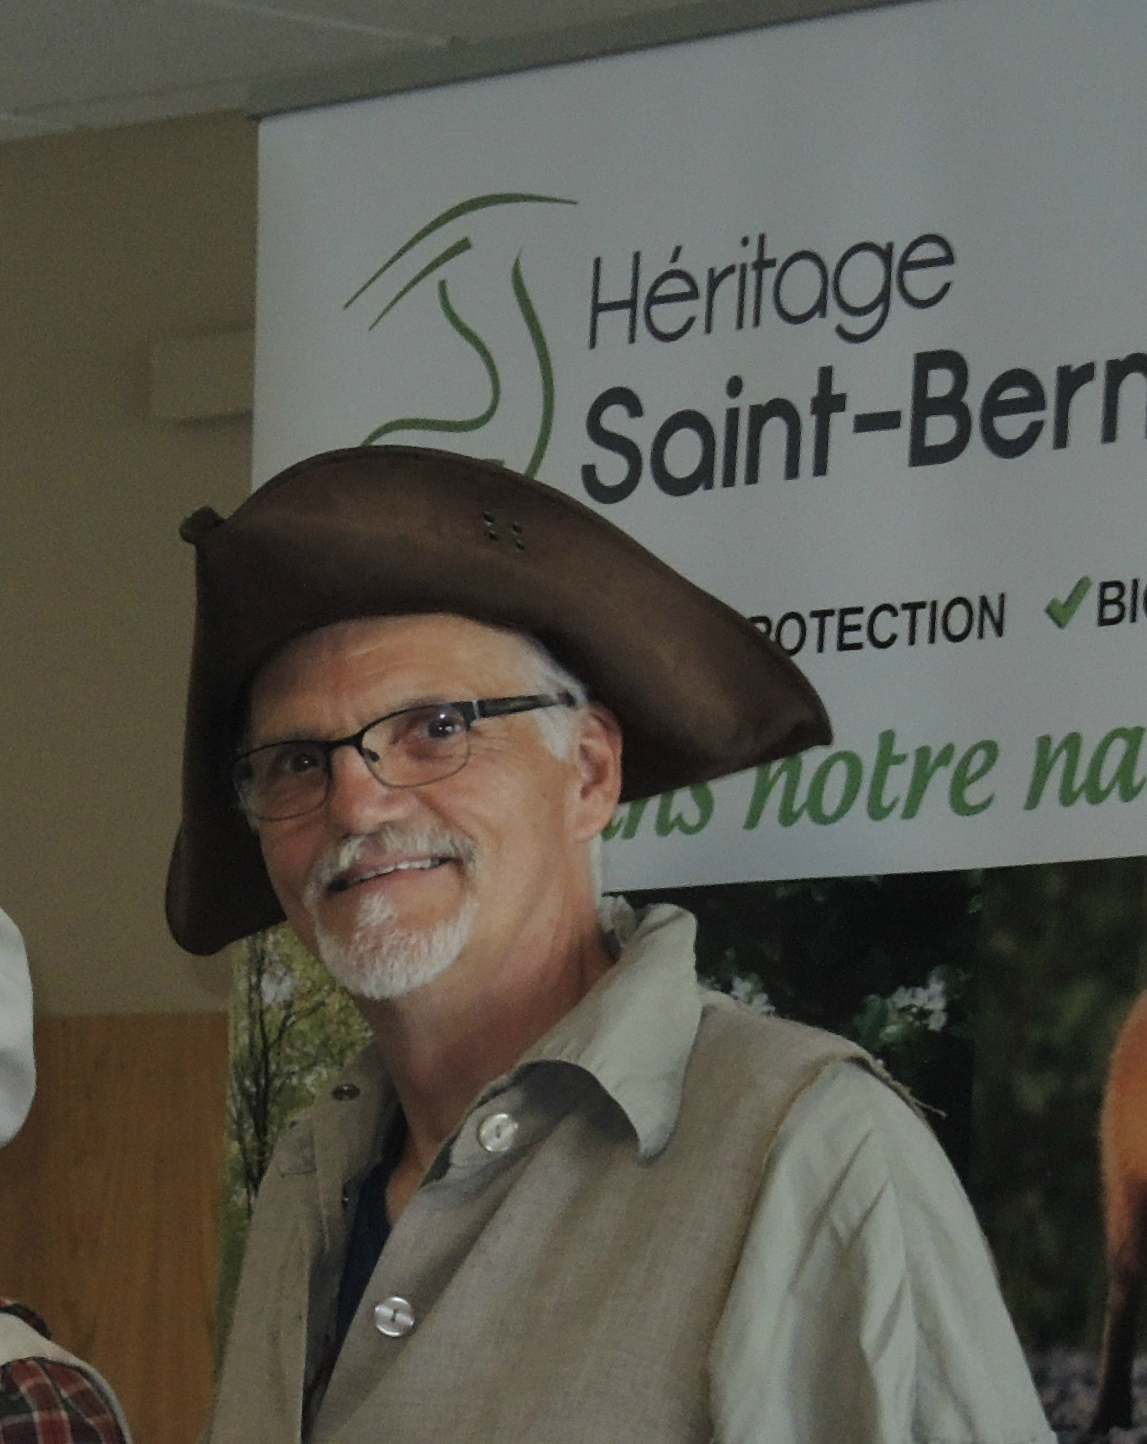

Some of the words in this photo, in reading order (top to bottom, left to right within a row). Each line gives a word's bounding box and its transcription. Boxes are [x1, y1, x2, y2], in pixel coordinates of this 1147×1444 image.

[587, 231, 956, 350] Héritage
[1097, 577, 1147, 627] BI
[743, 727, 1000, 830] notre
